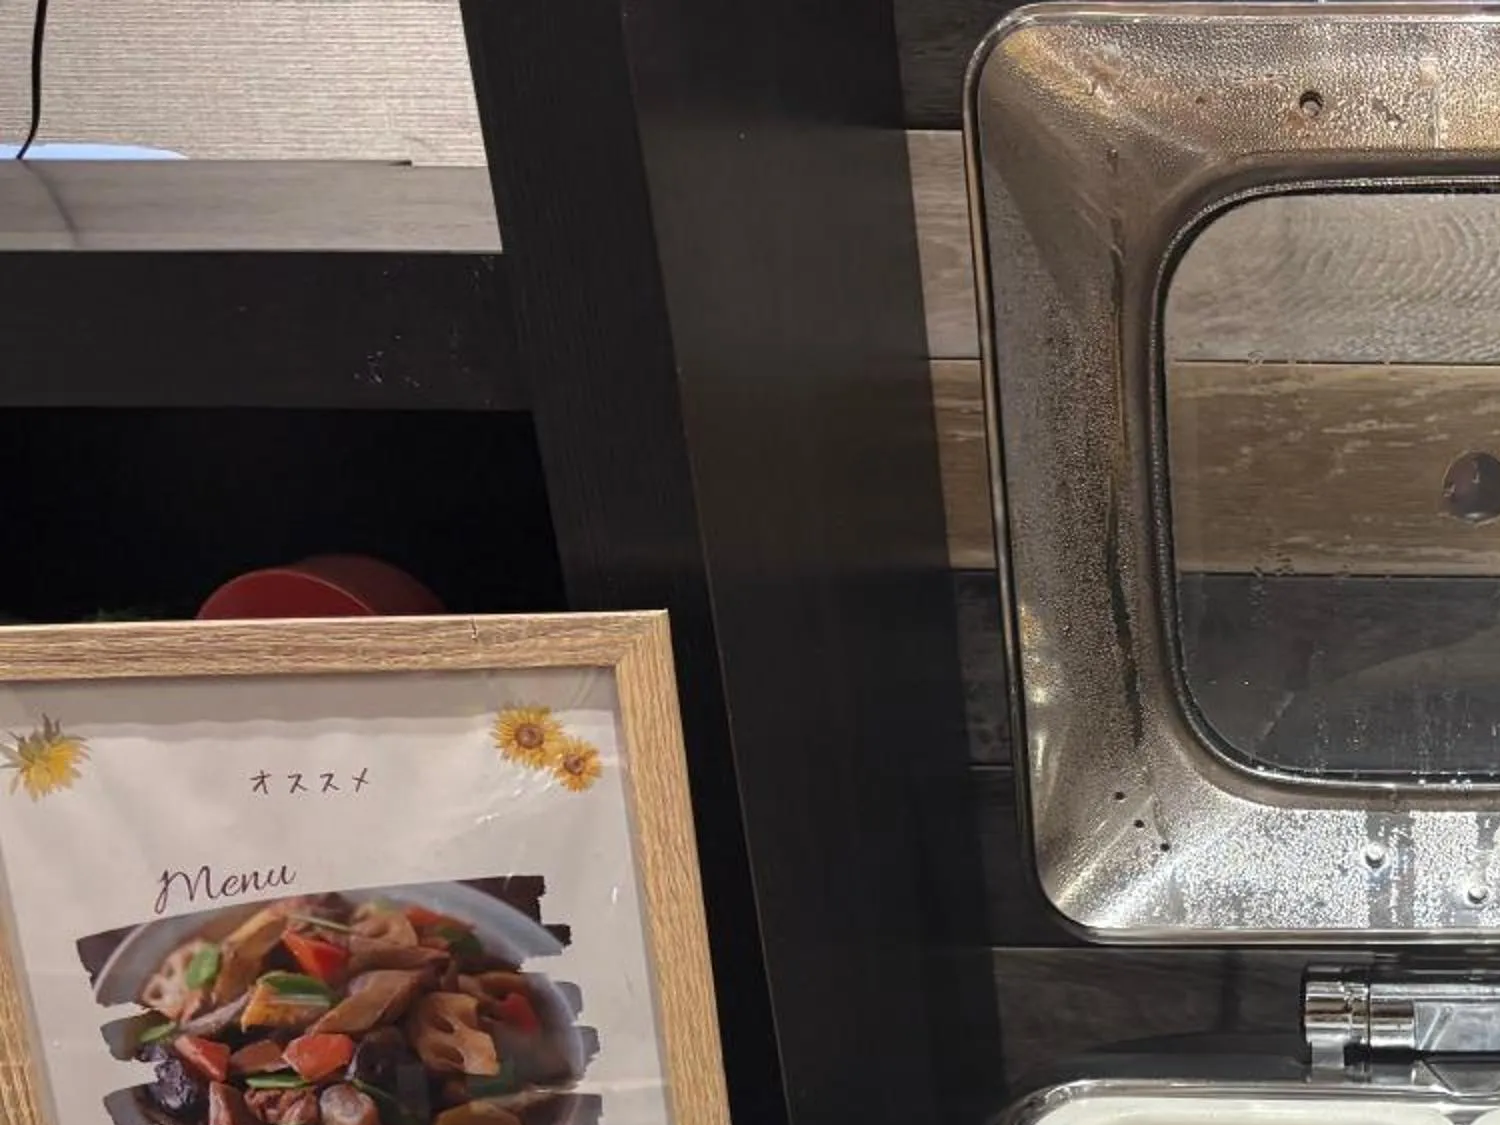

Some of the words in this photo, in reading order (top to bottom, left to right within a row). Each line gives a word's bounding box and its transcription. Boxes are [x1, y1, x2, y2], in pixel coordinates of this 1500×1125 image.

[249, 767, 370, 795] オススメ
[153, 863, 296, 914] Menu
